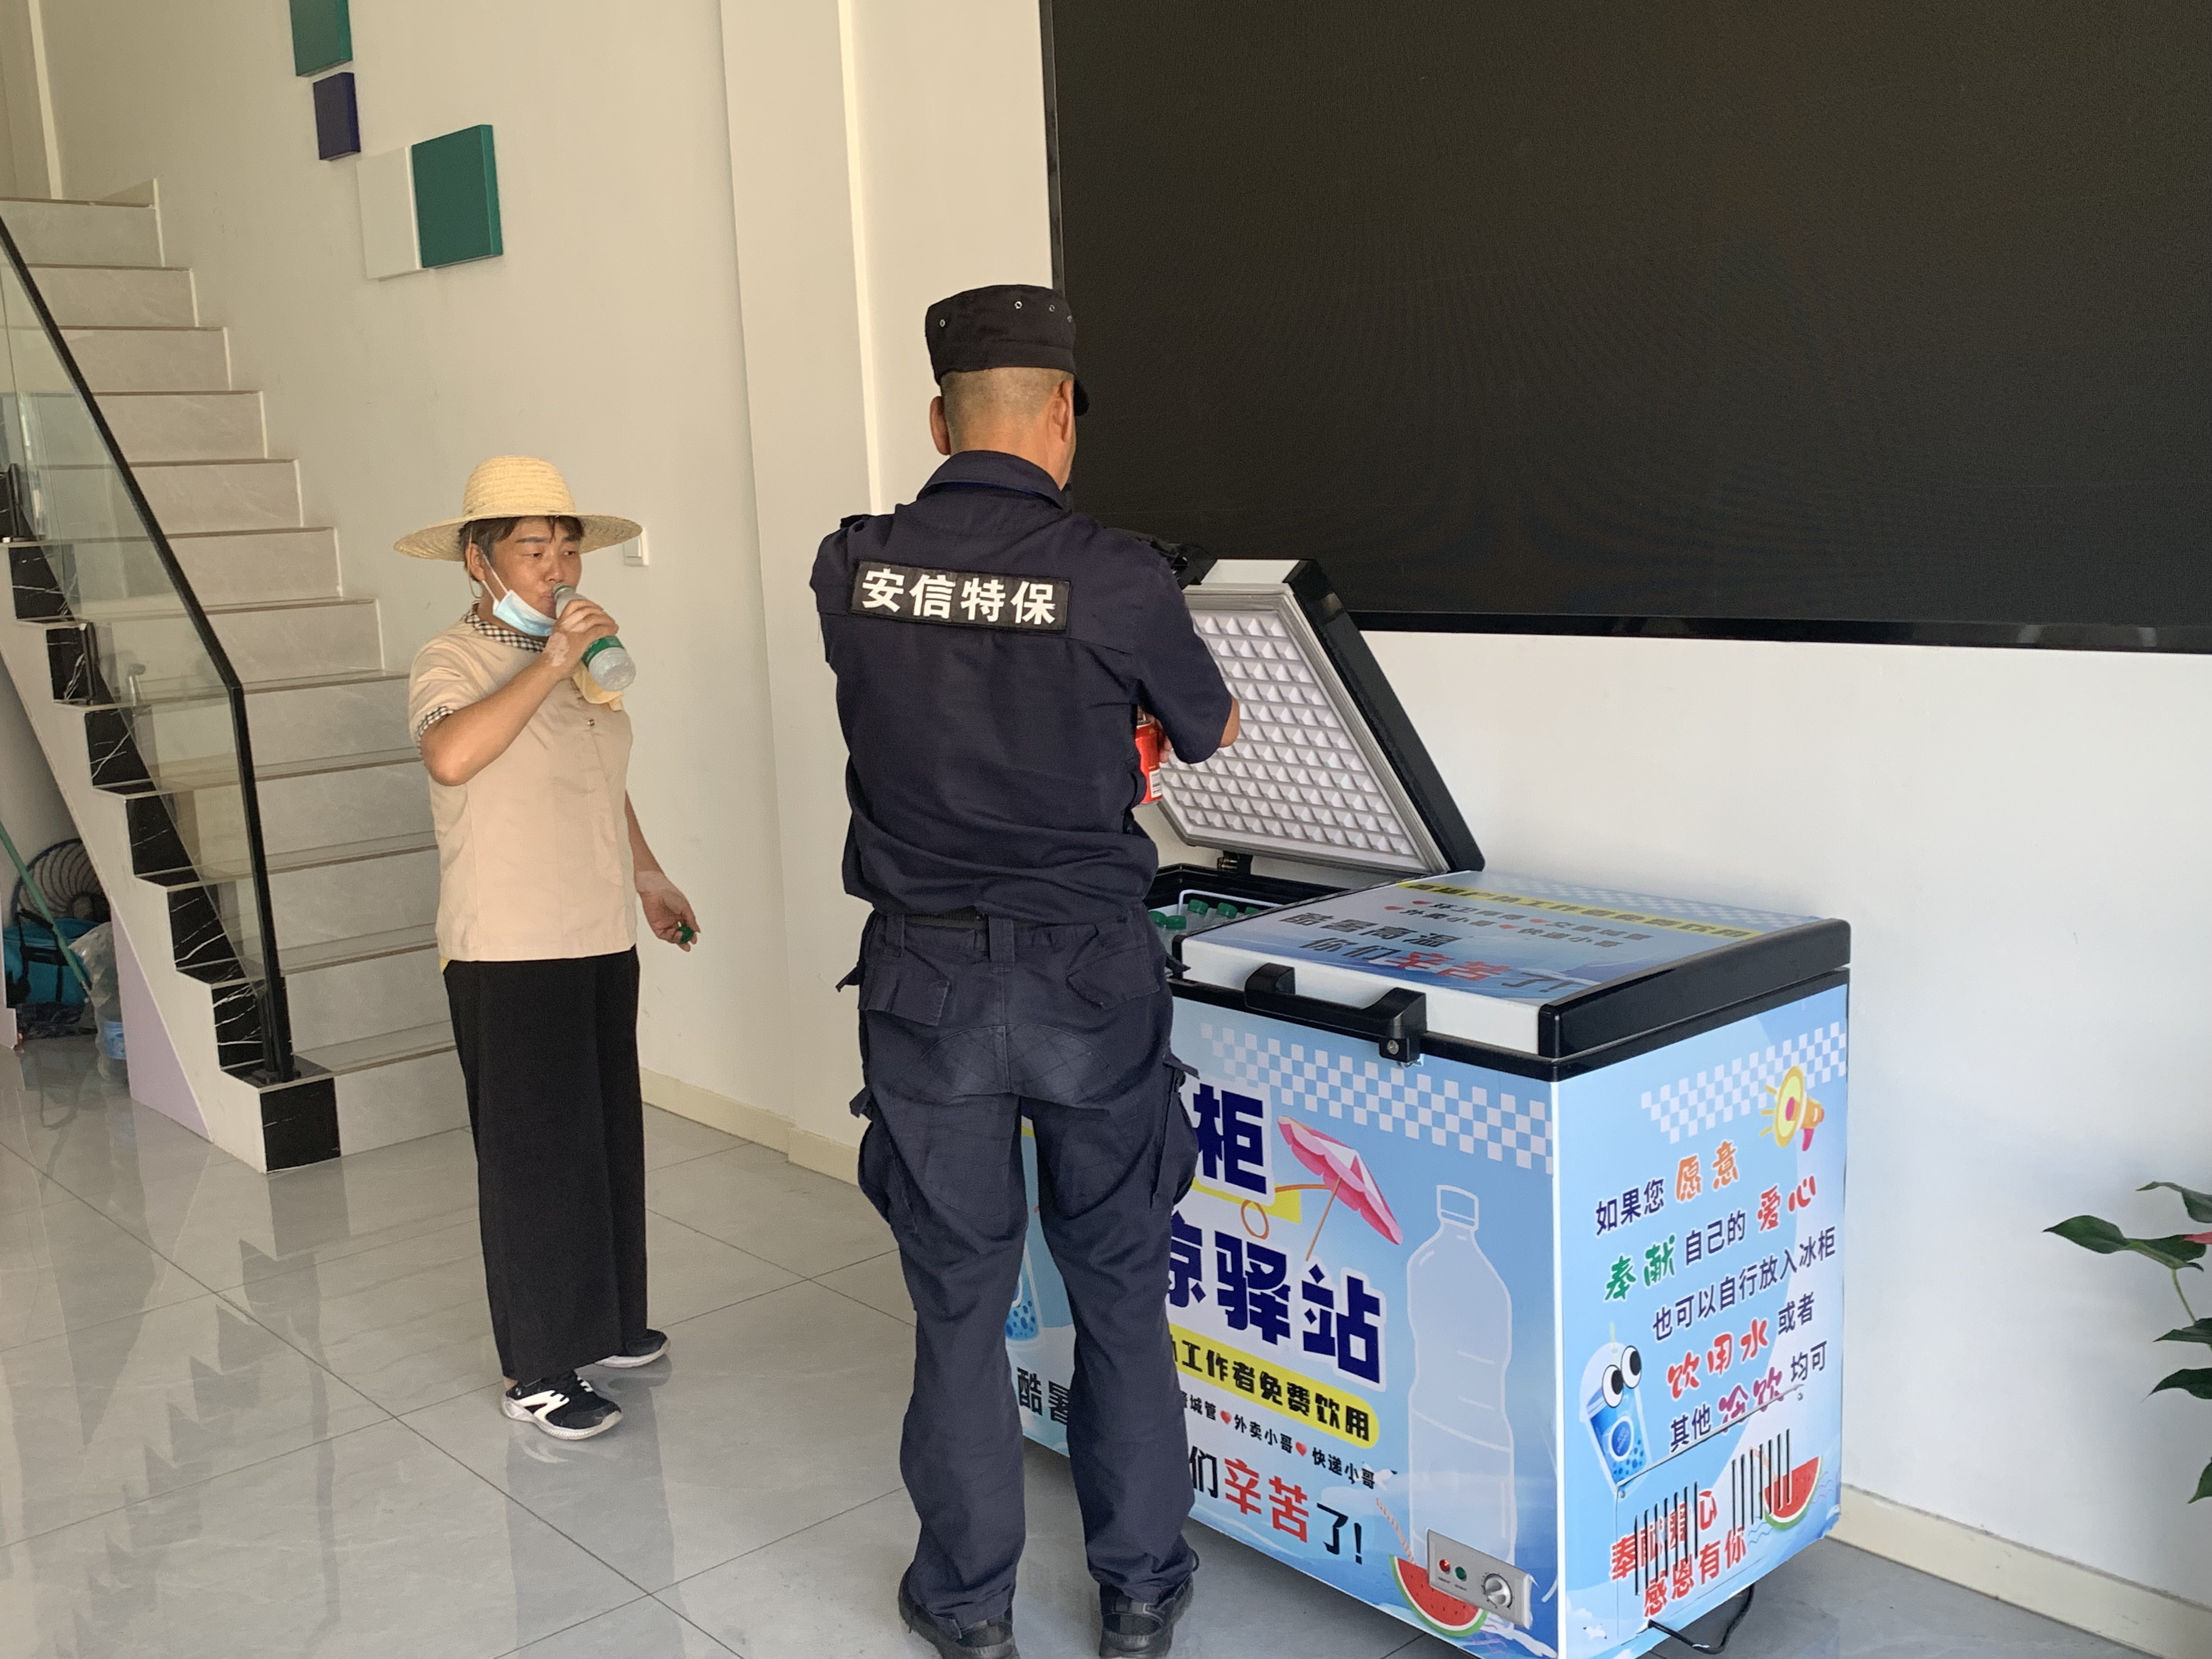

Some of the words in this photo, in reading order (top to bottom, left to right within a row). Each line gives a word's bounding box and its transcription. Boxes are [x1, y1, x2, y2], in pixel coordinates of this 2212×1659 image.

[861, 568, 1056, 625] 安信特保
[1279, 912, 1463, 947] 酷暑高温
[1400, 909, 1497, 927] 外卖小哥
[1191, 1083, 1267, 1195] 柜
[1596, 1141, 1739, 1235] 如果您愿意
[1604, 1176, 1816, 1301] 奉献自己的爱心
[1653, 1226, 1836, 1341] 也可以自行放入冰柜
[1170, 1334, 1369, 1442] 工作者免费饮用
[1668, 1291, 1815, 1399] 饮用水或者
[1670, 1340, 1827, 1452] 其他冷饮均可
[1234, 1414, 1293, 1454] 外卖小哥
[1312, 1447, 1375, 1489] 快递小哥
[1644, 1526, 1747, 1617] 感恩有你
